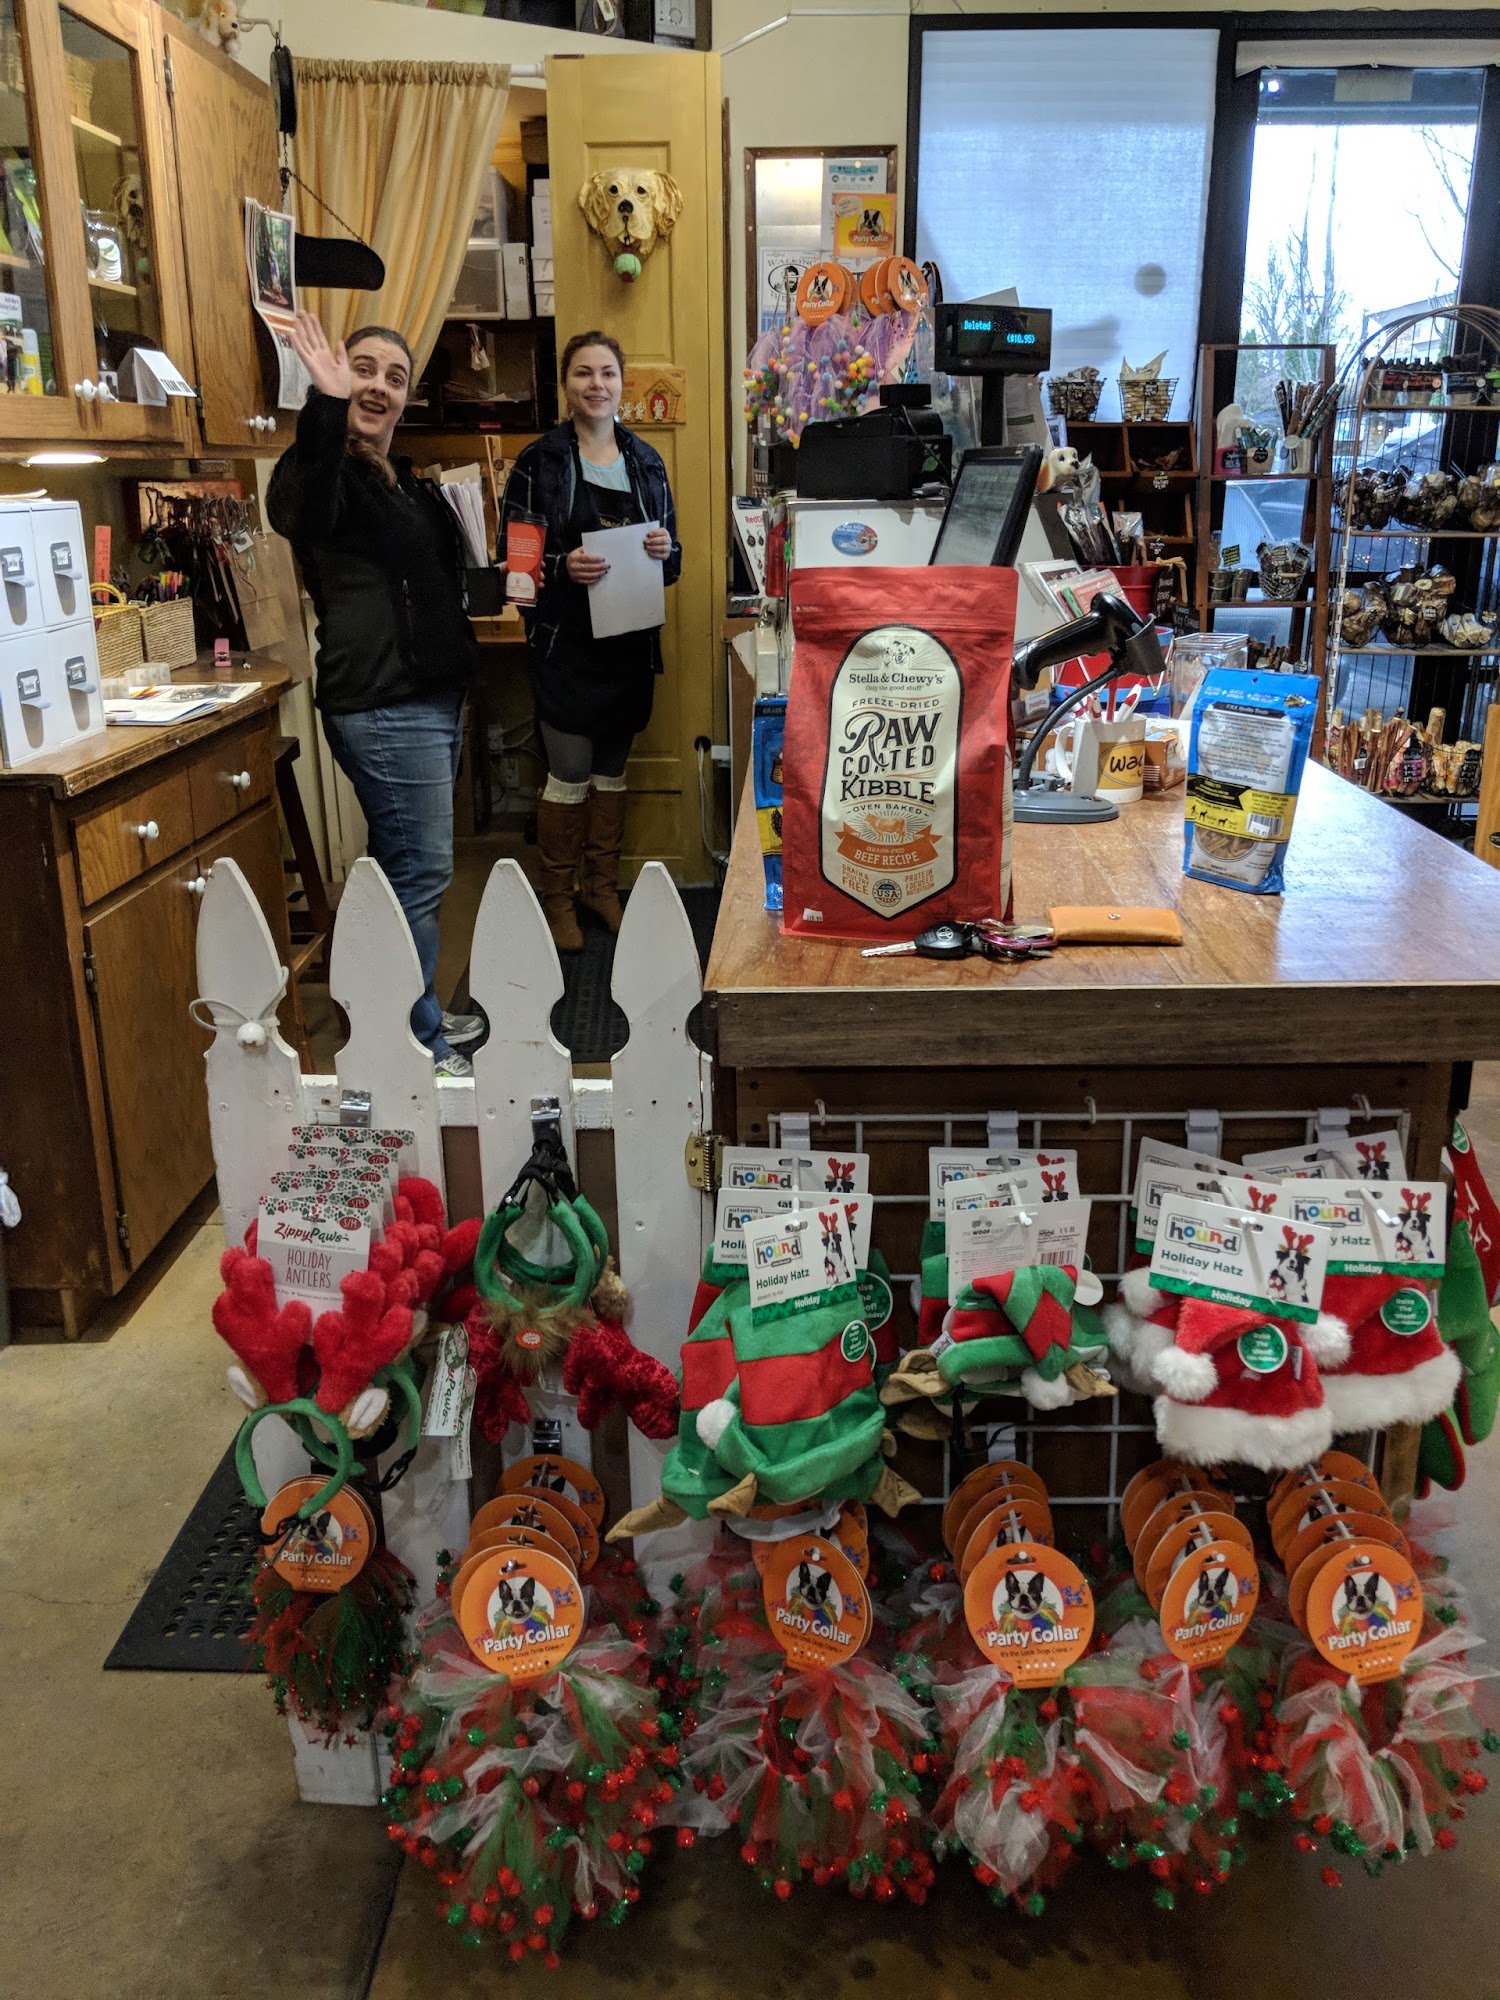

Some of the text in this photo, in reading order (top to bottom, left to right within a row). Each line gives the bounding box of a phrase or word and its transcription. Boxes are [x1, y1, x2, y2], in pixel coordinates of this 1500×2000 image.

[853, 234, 870, 243] Party
[802, 299, 835, 309] Party Collar
[964, 320, 991, 331] Deleted
[1006, 333, 1036, 344] ($10.95)
[849, 673, 943, 686] Stella & Chewy's
[763, 706, 785, 715] GRAIN-
[852, 698, 940, 709] FREEZE-DRIED
[838, 711, 942, 767] RAW
[842, 745, 935, 778] COATED
[840, 775, 936, 805] KIBBLE
[852, 803, 922, 815] OVEN BAKED
[854, 849, 919, 866] BEEF RECIPE
[842, 863, 863, 877] GRAIN
[905, 868, 933, 882] PROTEIN
[842, 870, 869, 886] POULTRY
[842, 876, 869, 895] FREE
[905, 875, 934, 890] FOCUSED
[876, 889, 898, 898] USA
[906, 882, 934, 896] NUTRITION
[384, 1136, 399, 1147] M/L
[372, 1155, 386, 1165] S/M
[733, 1171, 793, 1188] hound
[1151, 1184, 1178, 1192] outward
[351, 1198, 366, 1208] S/M
[956, 1196, 983, 1204] outward
[1171, 1216, 1203, 1227] outward
[1295, 1206, 1361, 1223] hound
[343, 1217, 358, 1229] S/M
[274, 1223, 346, 1243] ZippyPaws
[1169, 1222, 1238, 1251] hound
[721, 1240, 746, 1249] Holi
[756, 1236, 776, 1246] outward
[1342, 1236, 1371, 1246] Hatz
[287, 1248, 332, 1271] HOLIDAY
[756, 1240, 801, 1265] hound
[1159, 1264, 1180, 1274] Stretch
[1161, 1250, 1244, 1277] Holiday Hatz
[1344, 1264, 1383, 1275] Holiday
[286, 1266, 331, 1289] ANTLERS
[756, 1268, 810, 1290] Holiday Hatz
[794, 1294, 820, 1309] Holiday
[1211, 1289, 1252, 1307] Holiday
[442, 1369, 456, 1427] yPaws
[280, 1550, 352, 1567] Party Collar
[775, 1607, 852, 1645] Party Collar
[1175, 1623, 1207, 1642] Party
[1208, 1613, 1245, 1632] Collar
[484, 1624, 571, 1655] Party Collar
[987, 1625, 1081, 1648] Party Collar
[1328, 1620, 1412, 1651] Party Collar
